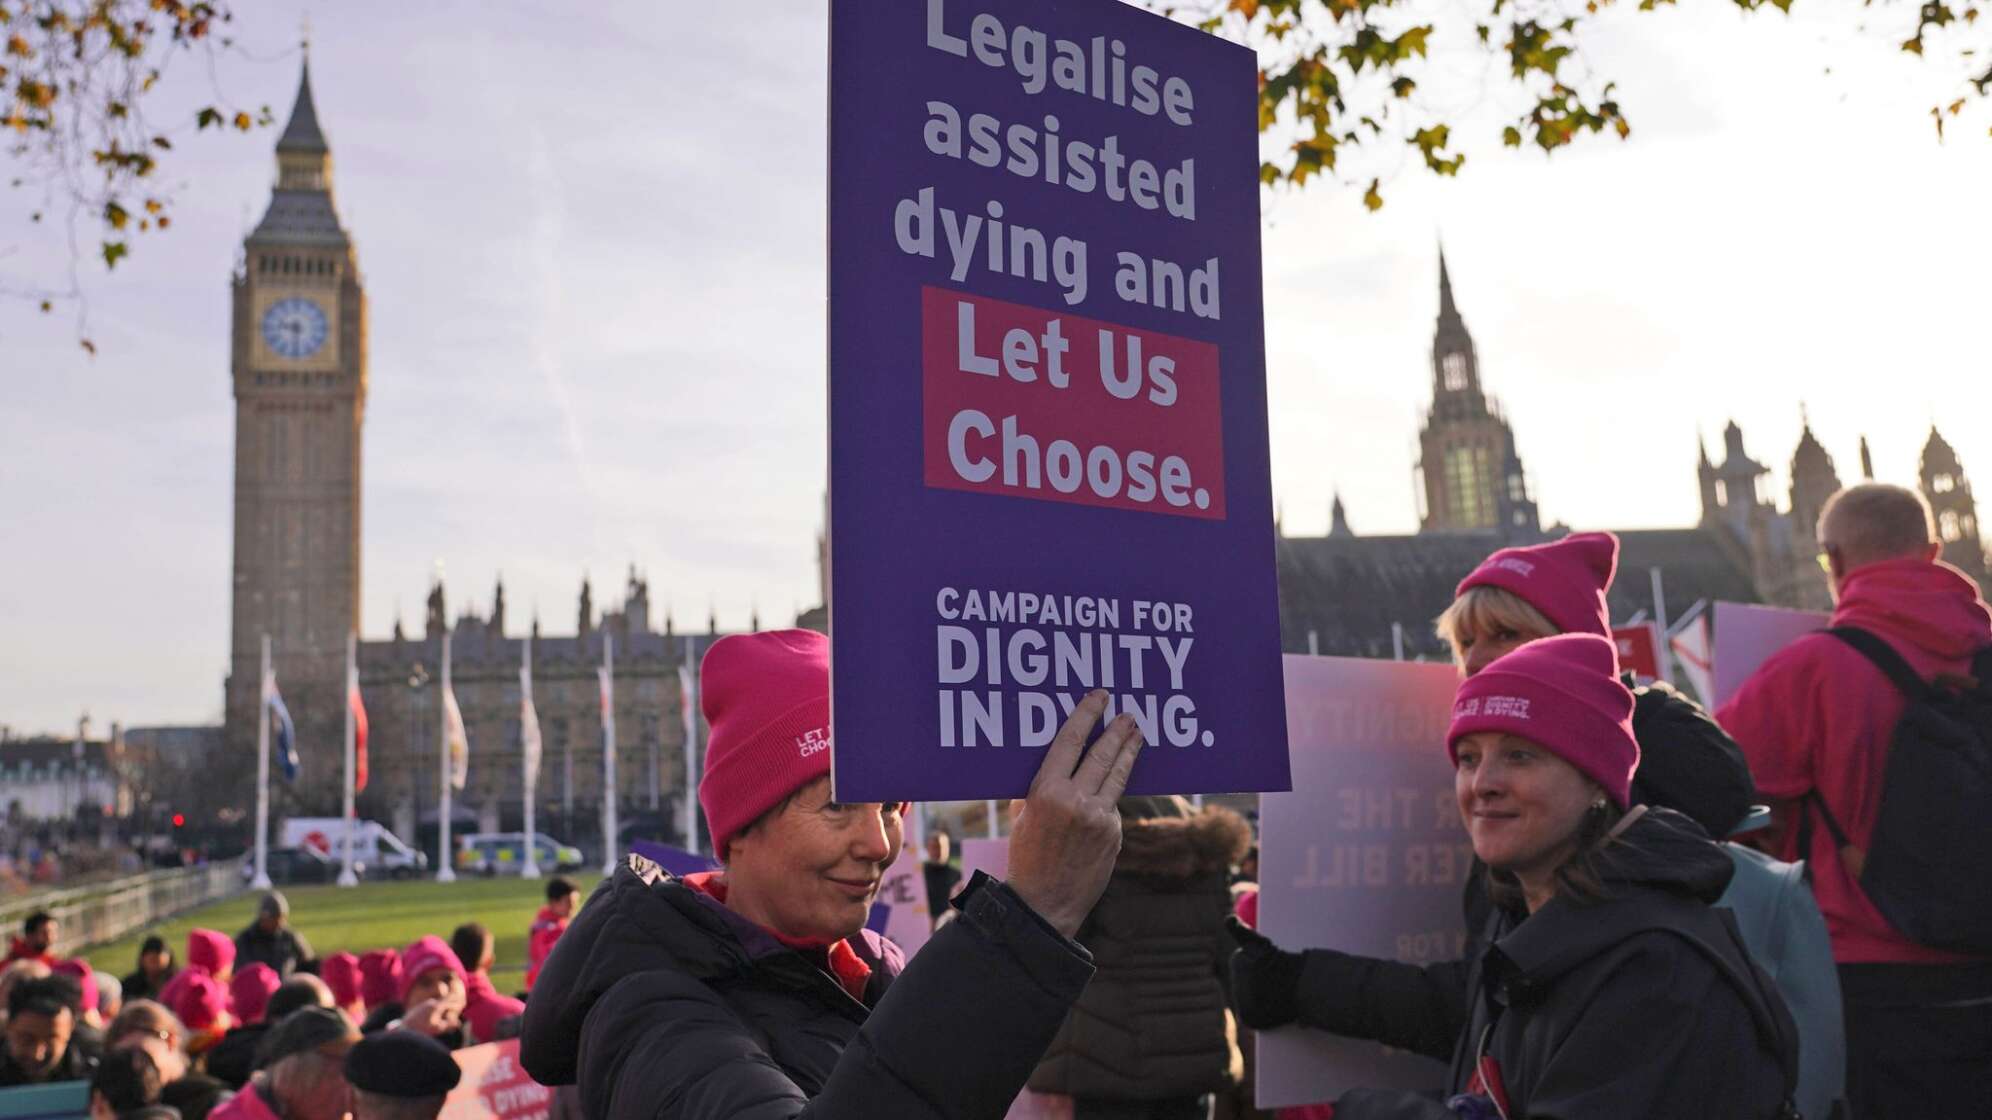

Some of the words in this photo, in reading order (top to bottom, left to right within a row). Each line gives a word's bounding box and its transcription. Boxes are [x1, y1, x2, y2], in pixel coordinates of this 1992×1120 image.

[927, 0, 1195, 126] Legalise
[924, 101, 1196, 221] assisted
[894, 187, 1088, 306] dying
[1115, 251, 1221, 320] and
[958, 301, 1070, 388] Let
[1099, 329, 1178, 406] Us
[947, 409, 1211, 510] Choose.
[936, 587, 1120, 629] CAMPAIGN
[1132, 600, 1194, 633] FOR
[937, 625, 1195, 690] DIGNITY
[795, 728, 822, 748] LET
[800, 737, 831, 757] CHO
[939, 690, 1004, 747] IN
